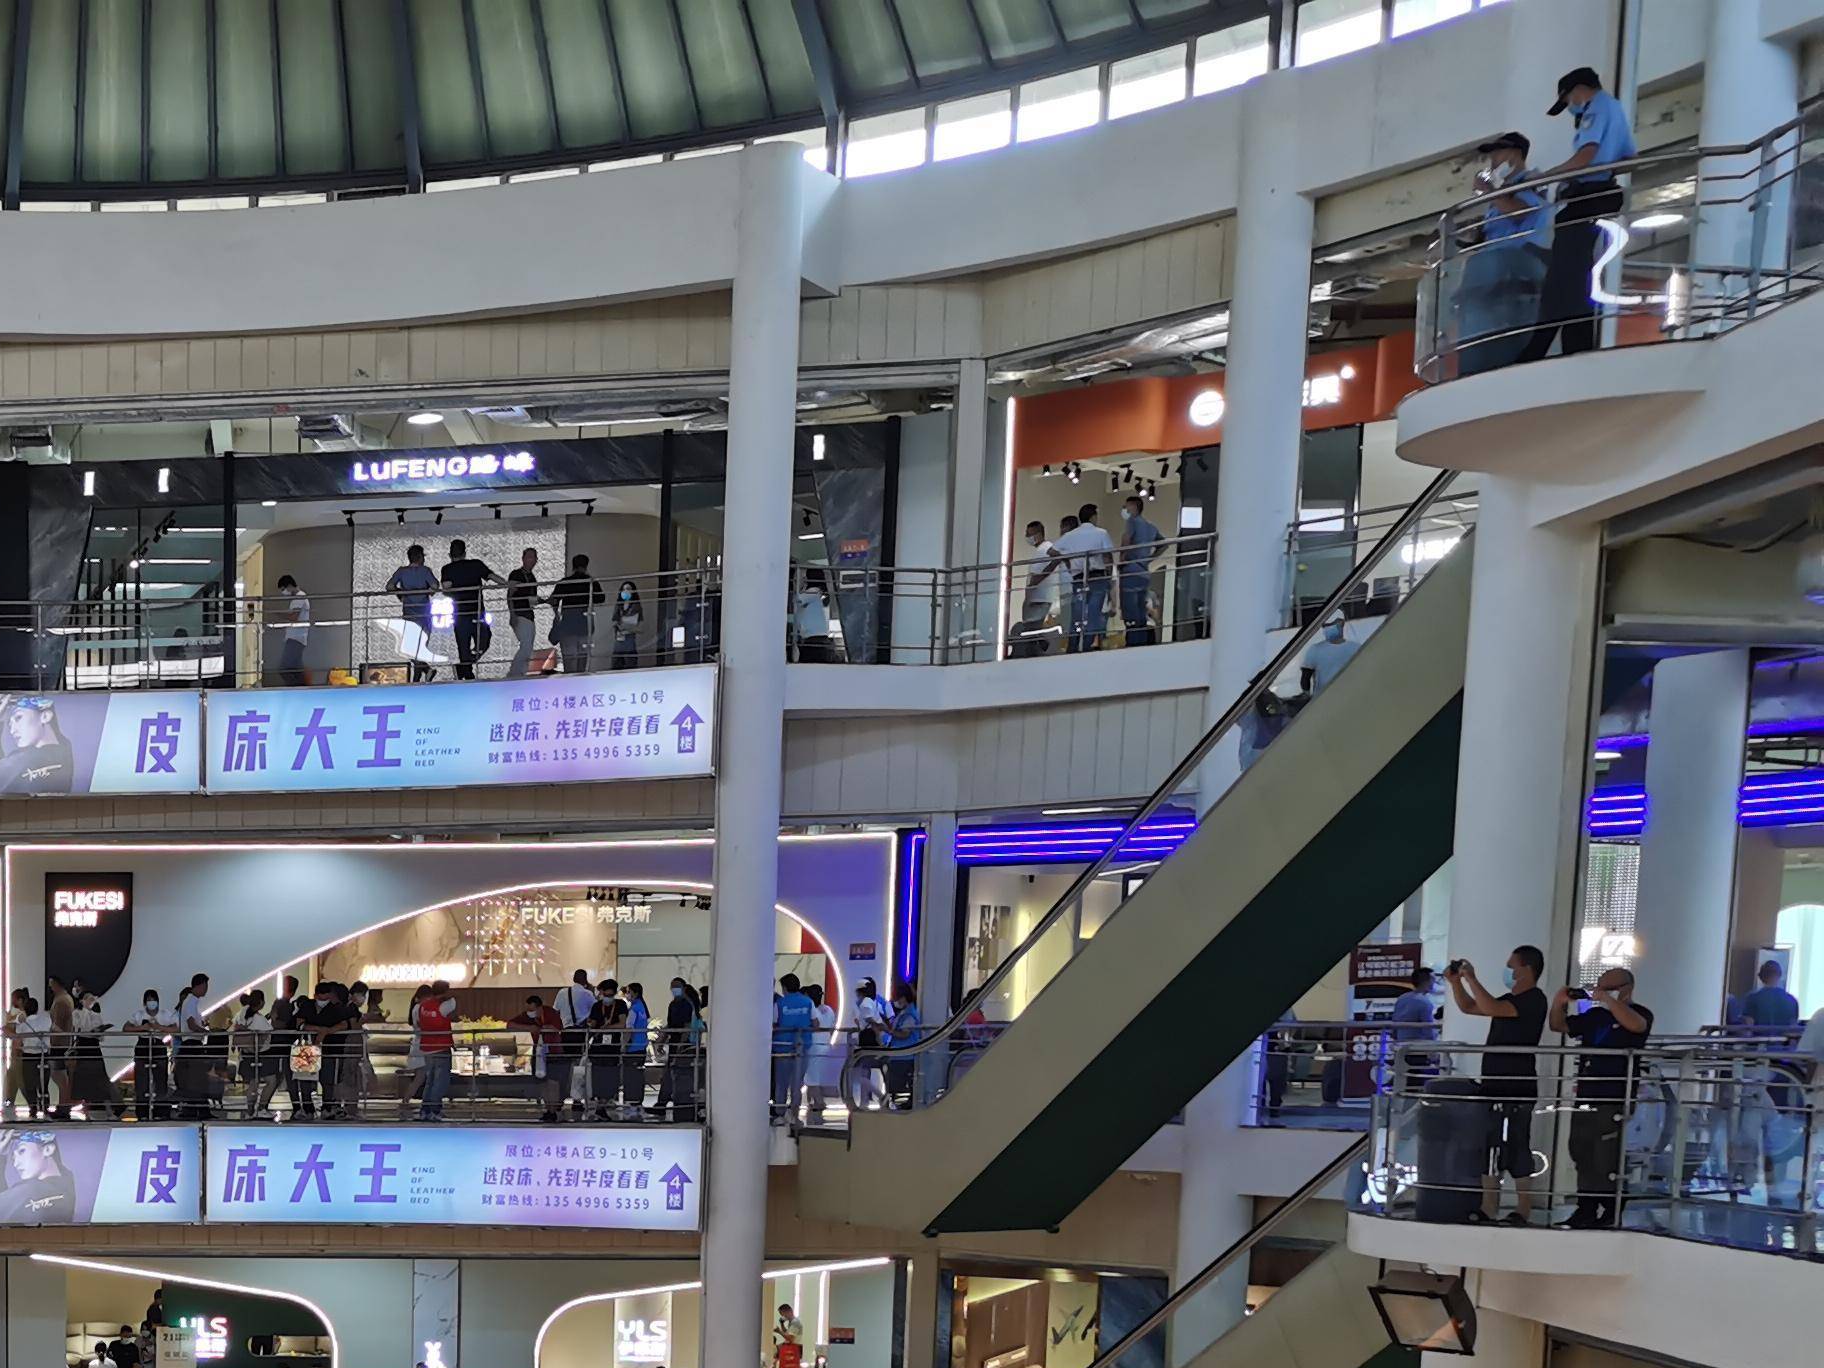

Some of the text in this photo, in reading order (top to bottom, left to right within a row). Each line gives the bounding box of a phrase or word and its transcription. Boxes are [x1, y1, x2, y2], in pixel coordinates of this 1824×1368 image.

[353, 456, 469, 482] LUFENG
[135, 704, 406, 774] 皮床大王
[415, 727, 441, 735] KING
[552, 748, 578, 761] 135
[584, 745, 619, 759] 4996
[625, 743, 661, 757] 5359
[54, 890, 125, 911] FUKESI
[520, 904, 653, 926] FUKESI 弗克斯
[135, 1143, 402, 1205] 皮床大王
[411, 1166, 436, 1174] KING
[544, 1195, 569, 1207] 135
[575, 1196, 610, 1209] 4996
[616, 1198, 650, 1210] 5359
[617, 1320, 668, 1342] YLS
